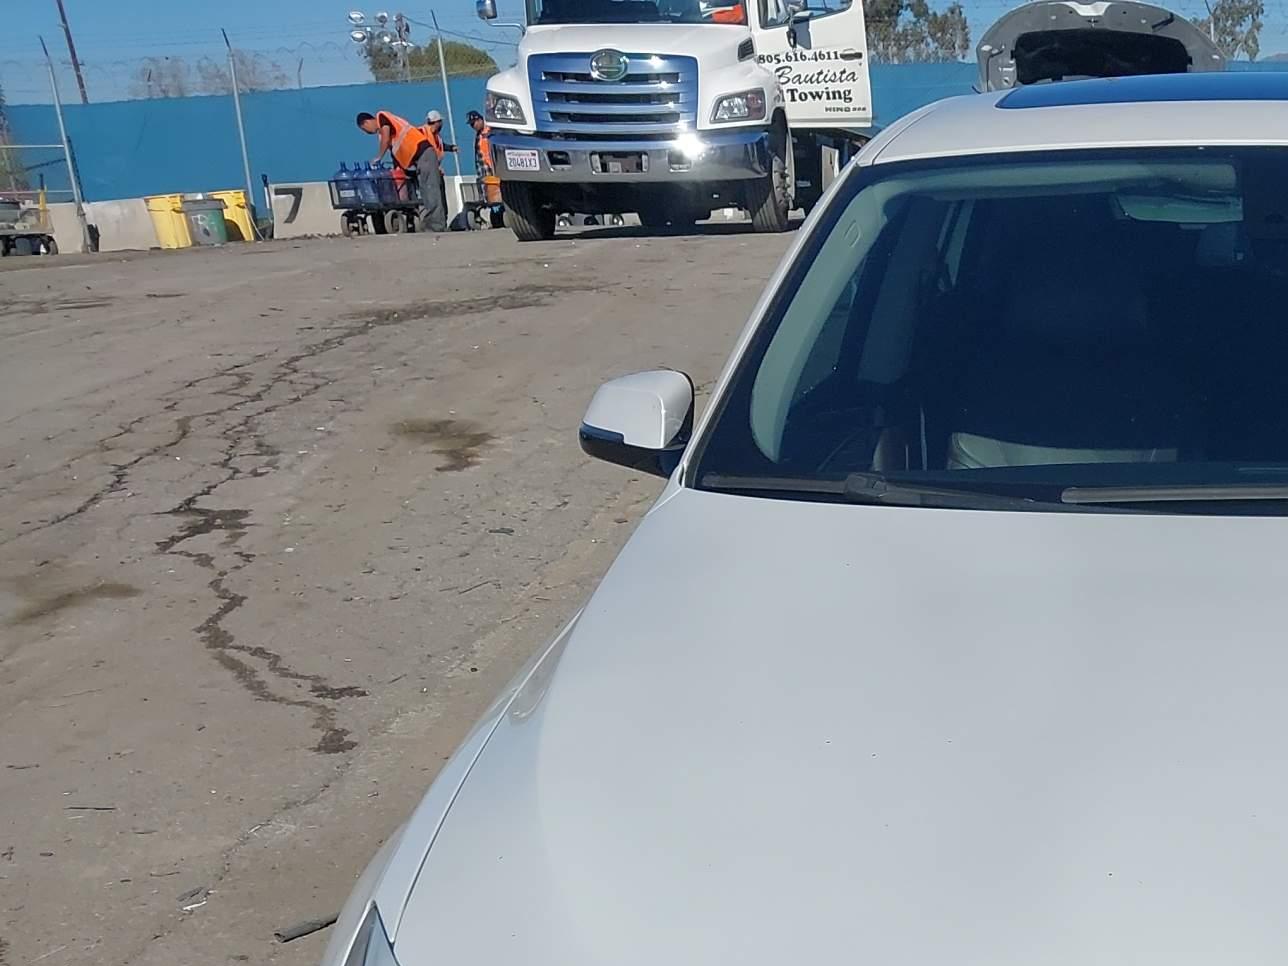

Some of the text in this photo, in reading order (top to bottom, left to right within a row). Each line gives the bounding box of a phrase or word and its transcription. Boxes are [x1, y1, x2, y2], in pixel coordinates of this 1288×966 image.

[758, 51, 839, 64] 805.616.4611
[775, 65, 859, 85] Bautista
[786, 87, 853, 104] Towing
[274, 188, 303, 224] 7
